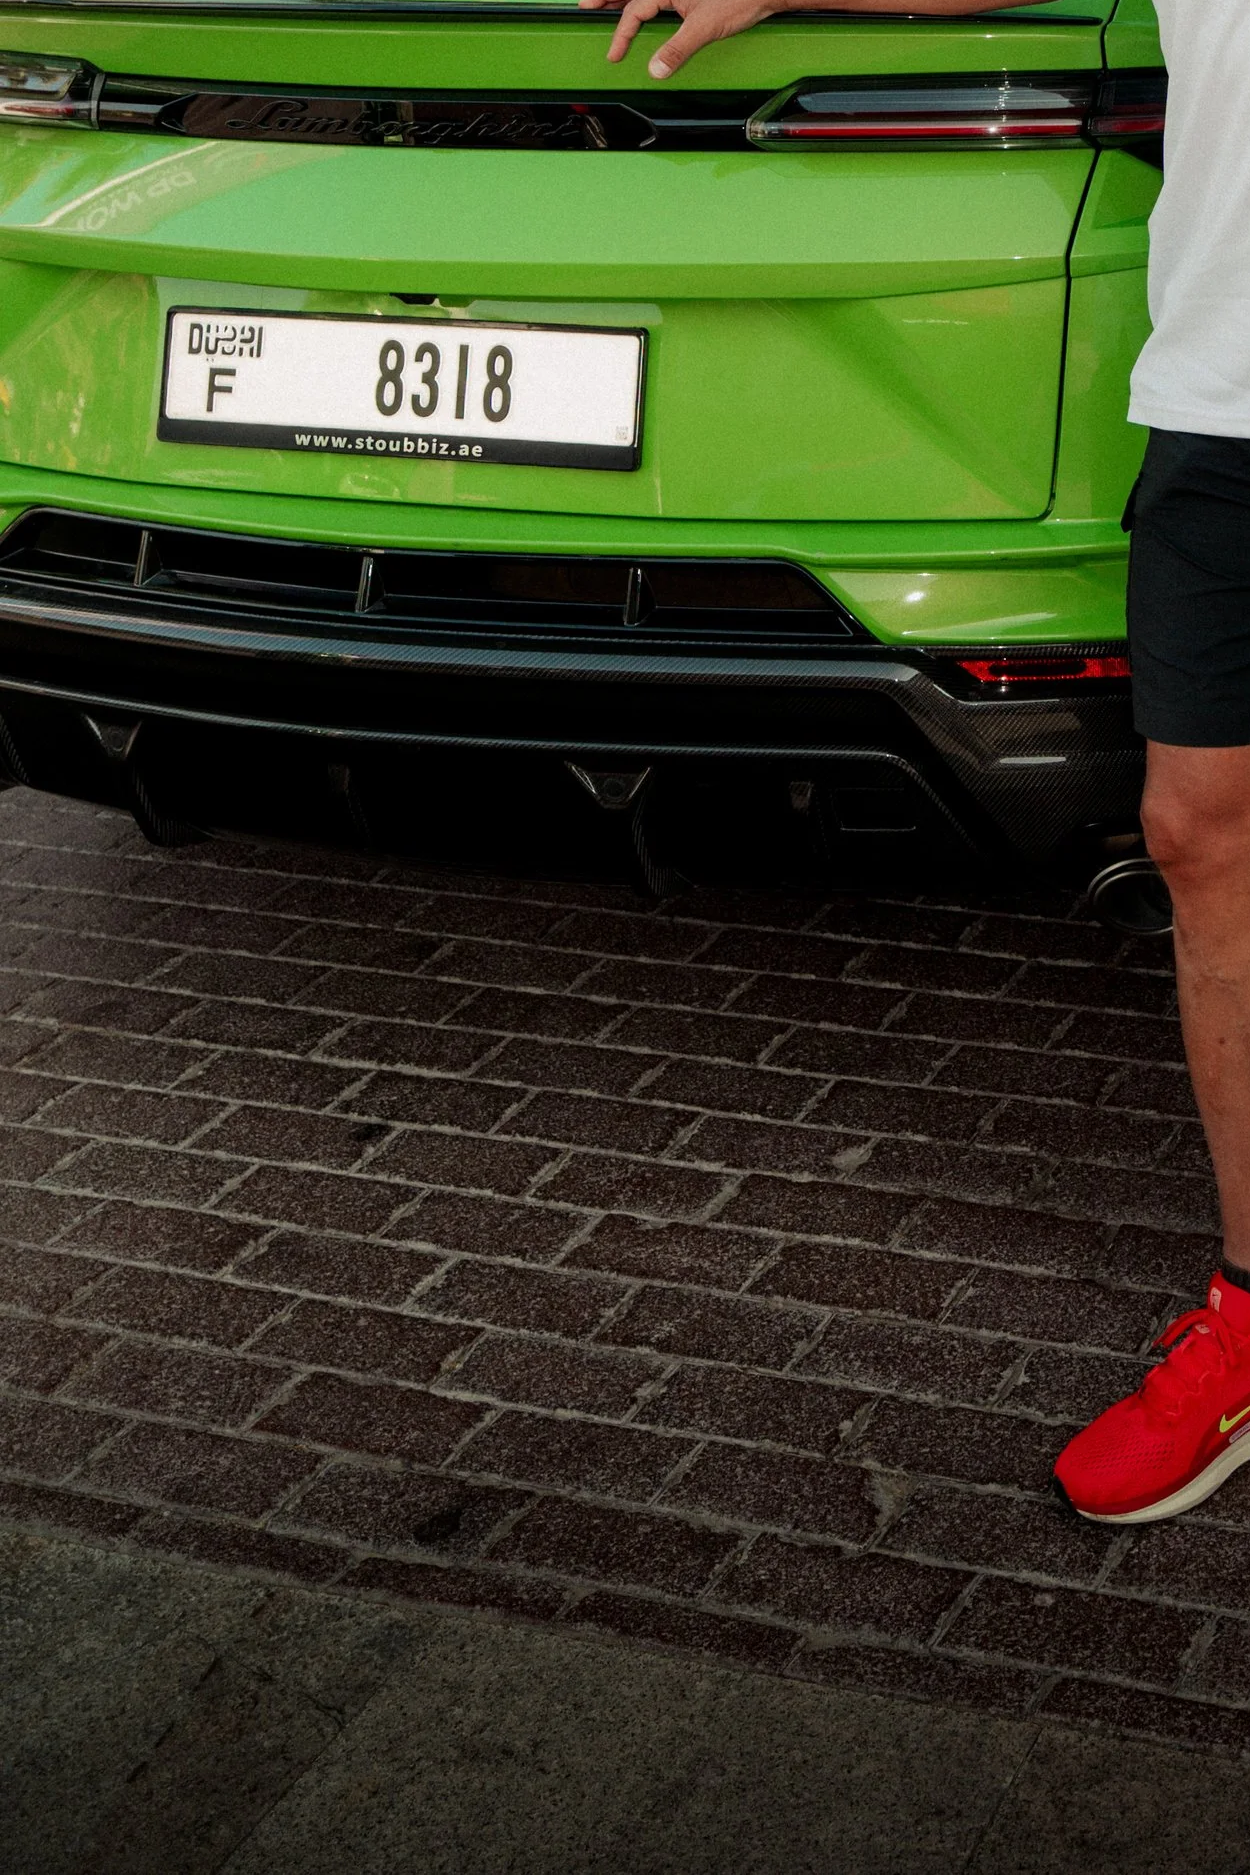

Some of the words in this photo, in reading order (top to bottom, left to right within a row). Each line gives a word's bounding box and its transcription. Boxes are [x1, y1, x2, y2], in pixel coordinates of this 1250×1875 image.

[188, 323, 264, 358] DUBAI
[206, 367, 237, 413] F
[375, 339, 513, 423] 8318
[295, 433, 484, 458] www.stoubbiz.ae
